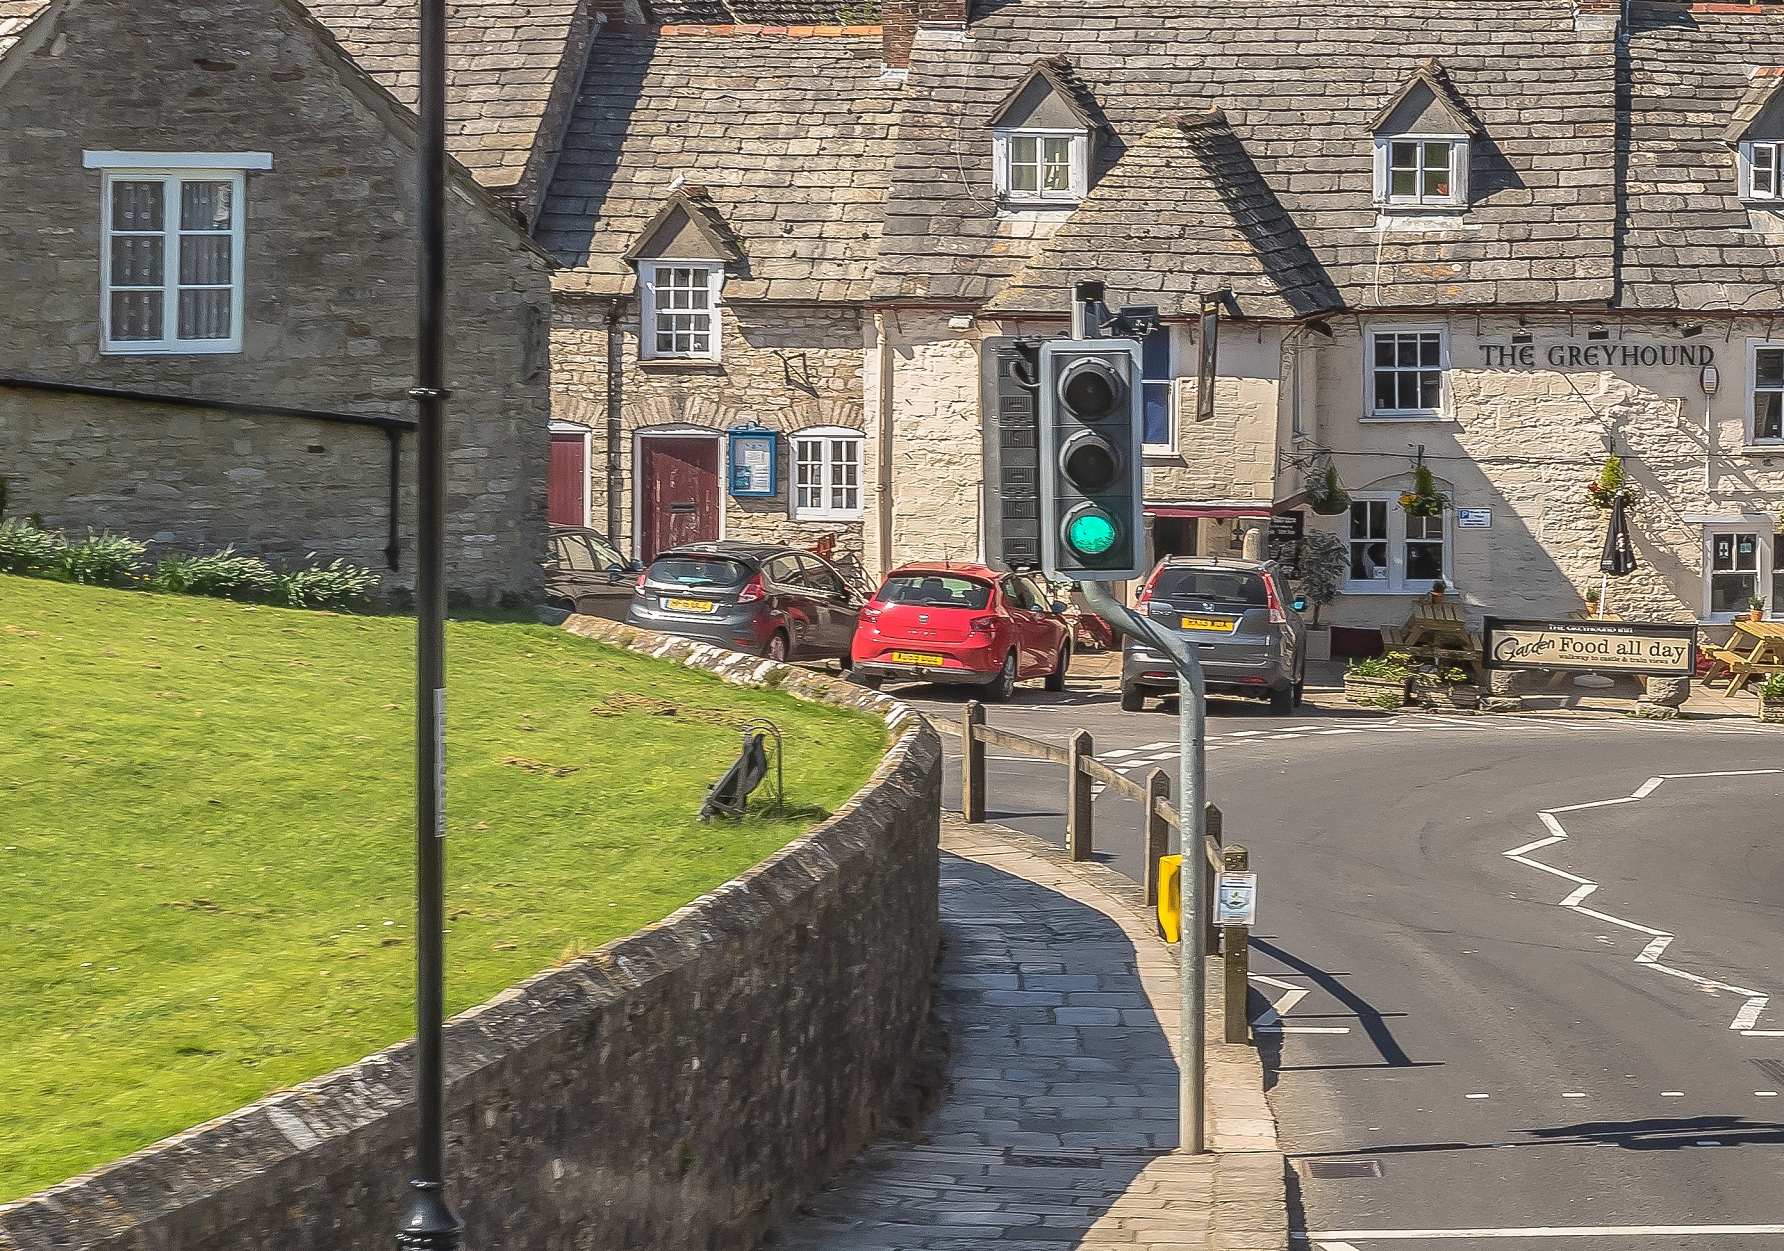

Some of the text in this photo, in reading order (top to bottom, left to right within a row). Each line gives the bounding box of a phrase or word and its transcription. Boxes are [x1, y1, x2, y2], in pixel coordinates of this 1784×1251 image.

[1479, 345, 1715, 366] THE GREYHOUND
[1494, 633, 1556, 663] Garden
[1558, 636, 1687, 664] Food all day
